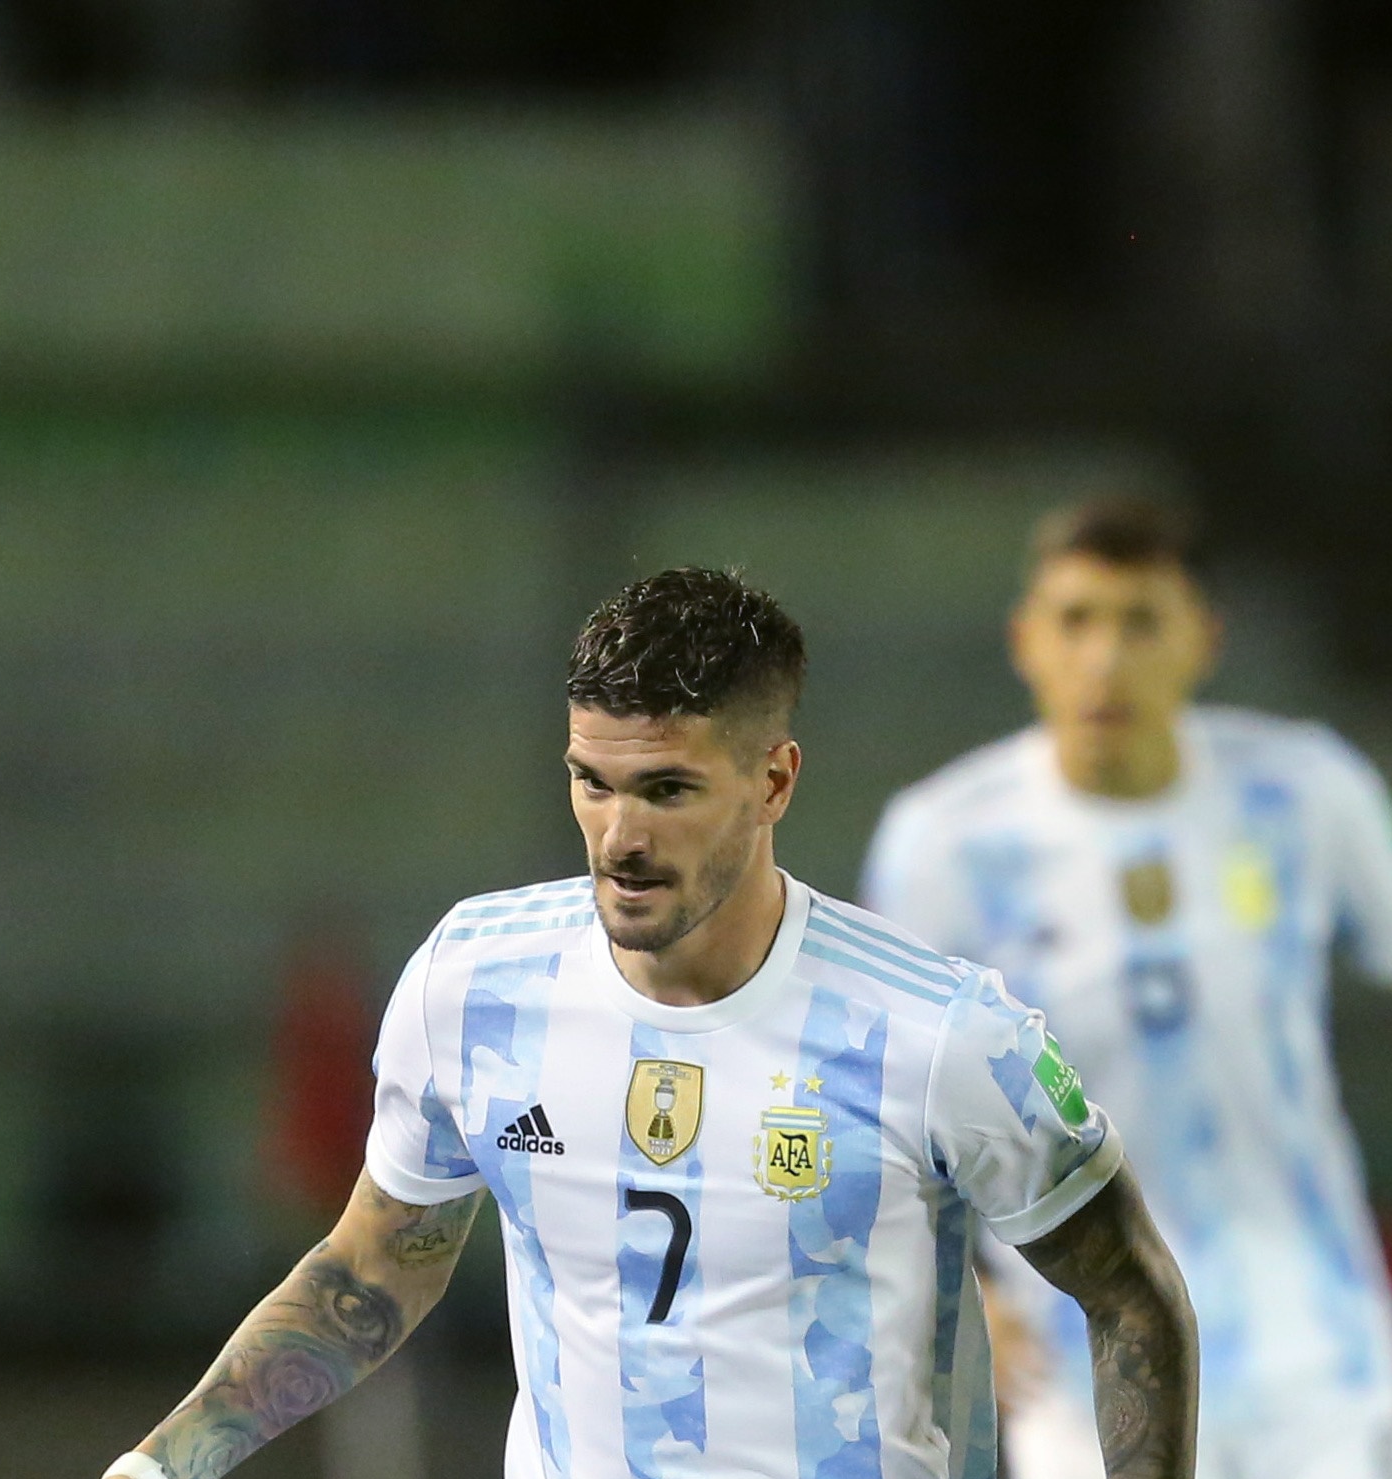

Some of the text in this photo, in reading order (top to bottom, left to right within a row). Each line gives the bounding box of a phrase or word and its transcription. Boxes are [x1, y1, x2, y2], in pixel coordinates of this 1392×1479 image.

[496, 1132, 565, 1156] adidas
[769, 1130, 813, 1177] AFA
[625, 1188, 692, 1325] 7
